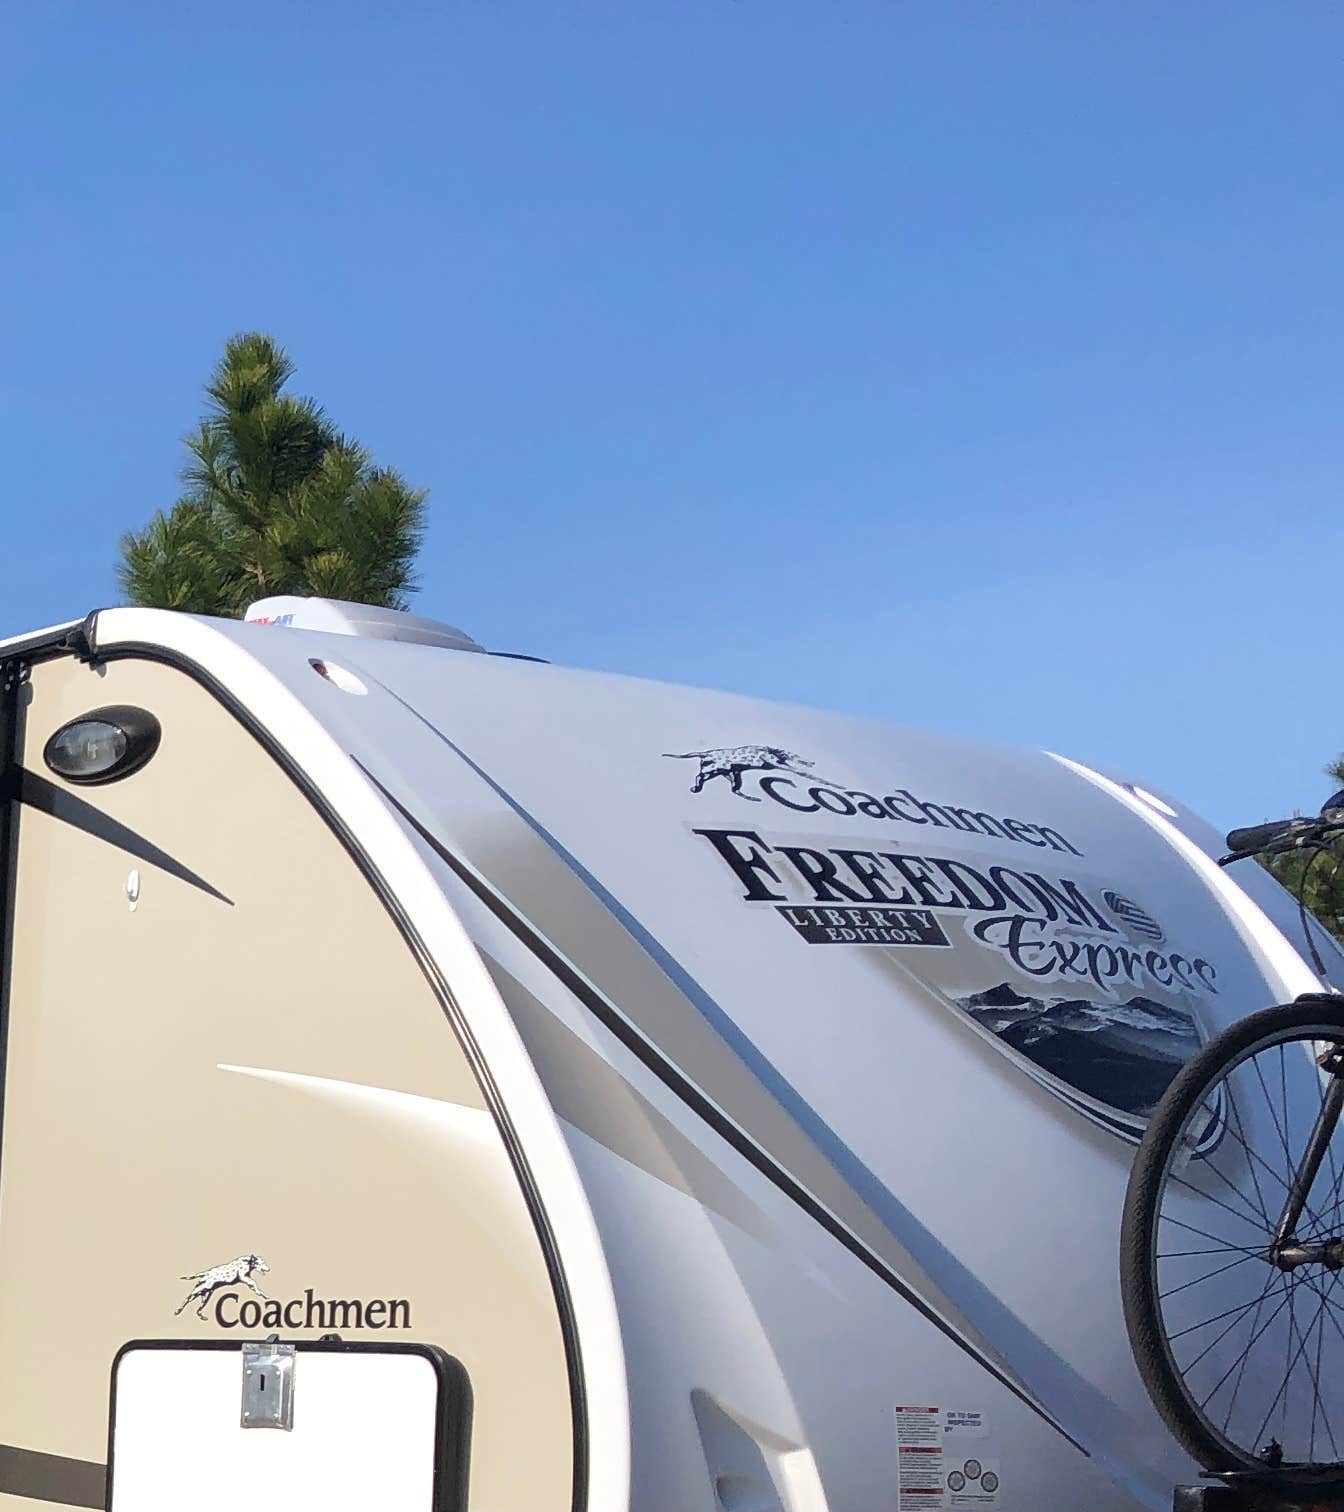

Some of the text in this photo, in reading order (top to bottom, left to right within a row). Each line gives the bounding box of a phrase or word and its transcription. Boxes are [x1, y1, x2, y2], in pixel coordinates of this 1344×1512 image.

[759, 776, 1084, 857] Coachmen
[692, 828, 1119, 933] FREEDOM
[784, 908, 934, 929] LIBERTY
[827, 926, 923, 943] EDITION
[973, 914, 1219, 994] Express
[214, 1288, 412, 1329] Coachmen
